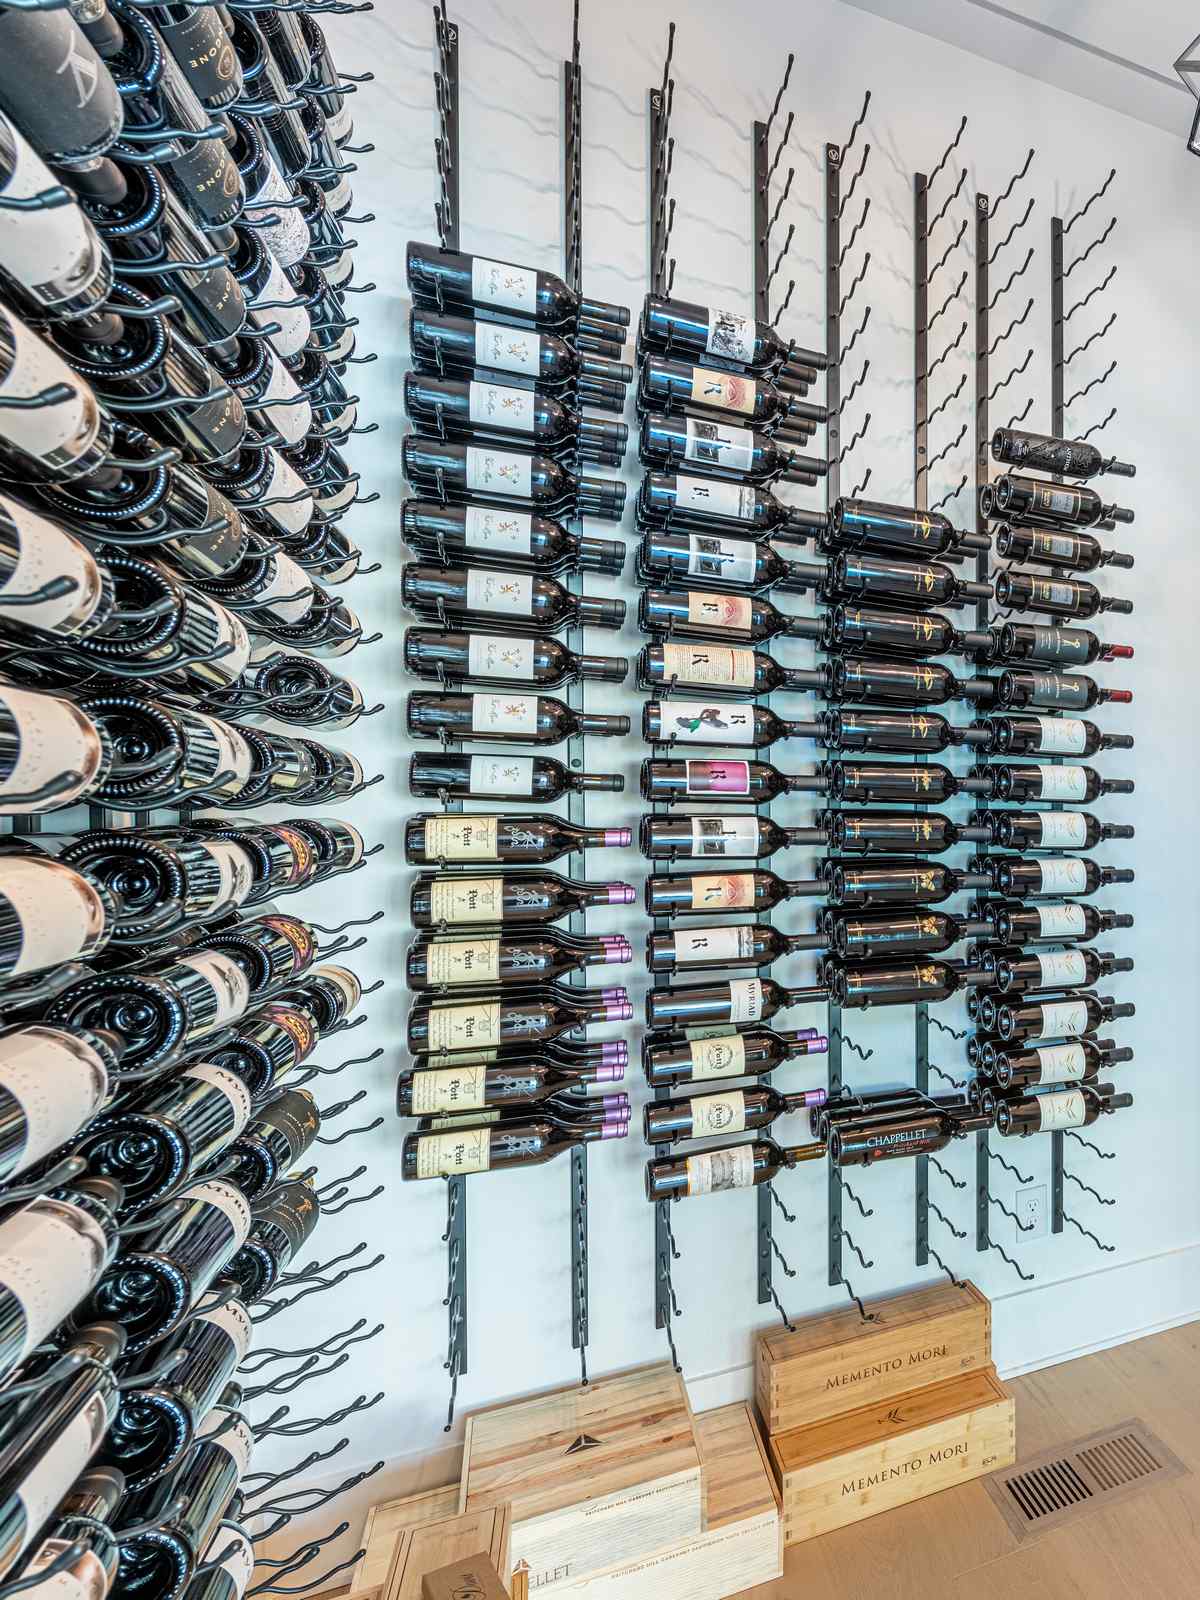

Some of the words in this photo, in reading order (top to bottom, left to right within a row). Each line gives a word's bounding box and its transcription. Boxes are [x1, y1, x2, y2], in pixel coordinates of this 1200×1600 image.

[463, 825, 473, 846] Pott
[468, 888, 478, 910] Pott
[464, 948, 475, 970] Pott
[465, 1016, 475, 1038] Pott
[450, 1079, 461, 1101] Pott
[866, 1128, 927, 1148] CHAPPELLET
[455, 1144, 465, 1165] Pott
[824, 1358, 903, 1390] MEMENTO
[908, 1344, 948, 1366] MORI
[841, 1457, 923, 1497] MEMENTO
[929, 1441, 969, 1466] MORI
